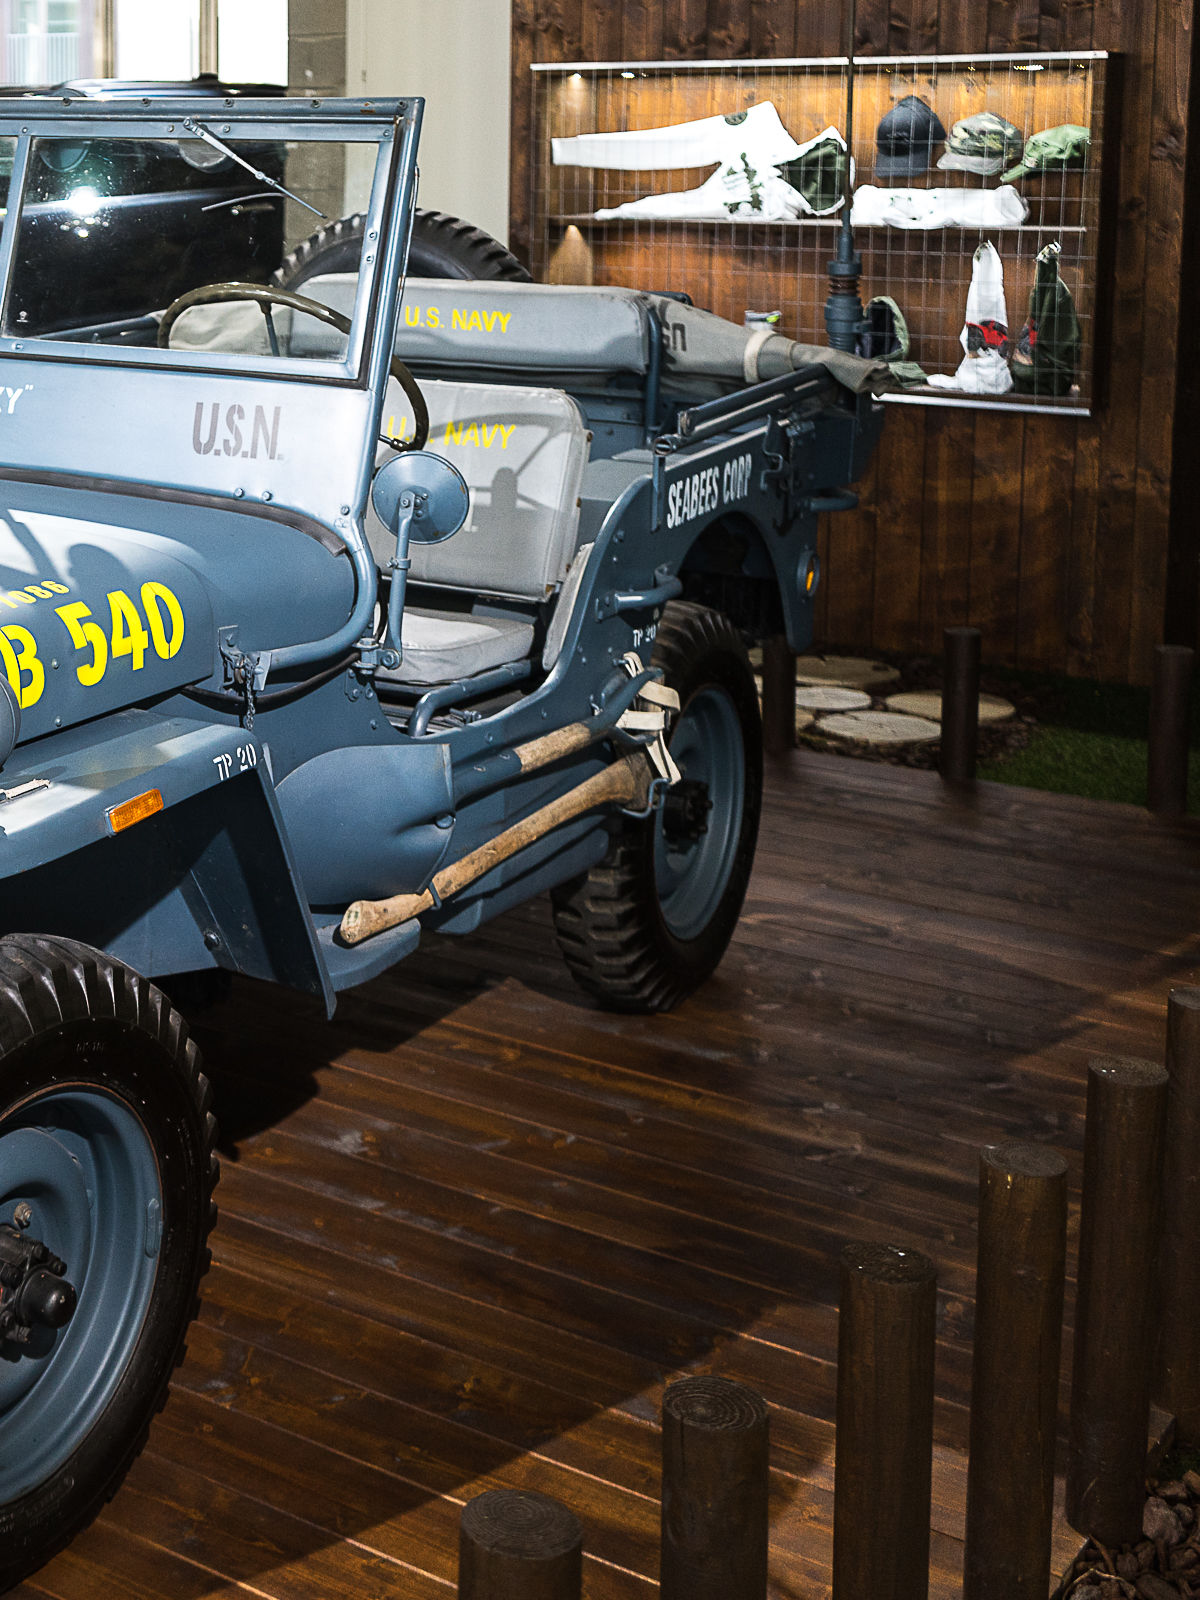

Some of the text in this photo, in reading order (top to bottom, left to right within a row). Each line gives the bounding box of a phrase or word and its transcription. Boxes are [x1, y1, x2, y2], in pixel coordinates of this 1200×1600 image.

[405, 306, 512, 333] U.S. NAVY
[444, 421, 517, 449] NAVY
[667, 453, 752, 529] SEABEES CORP
[54, 581, 185, 687] 540
[213, 743, 257, 781] TP 20
